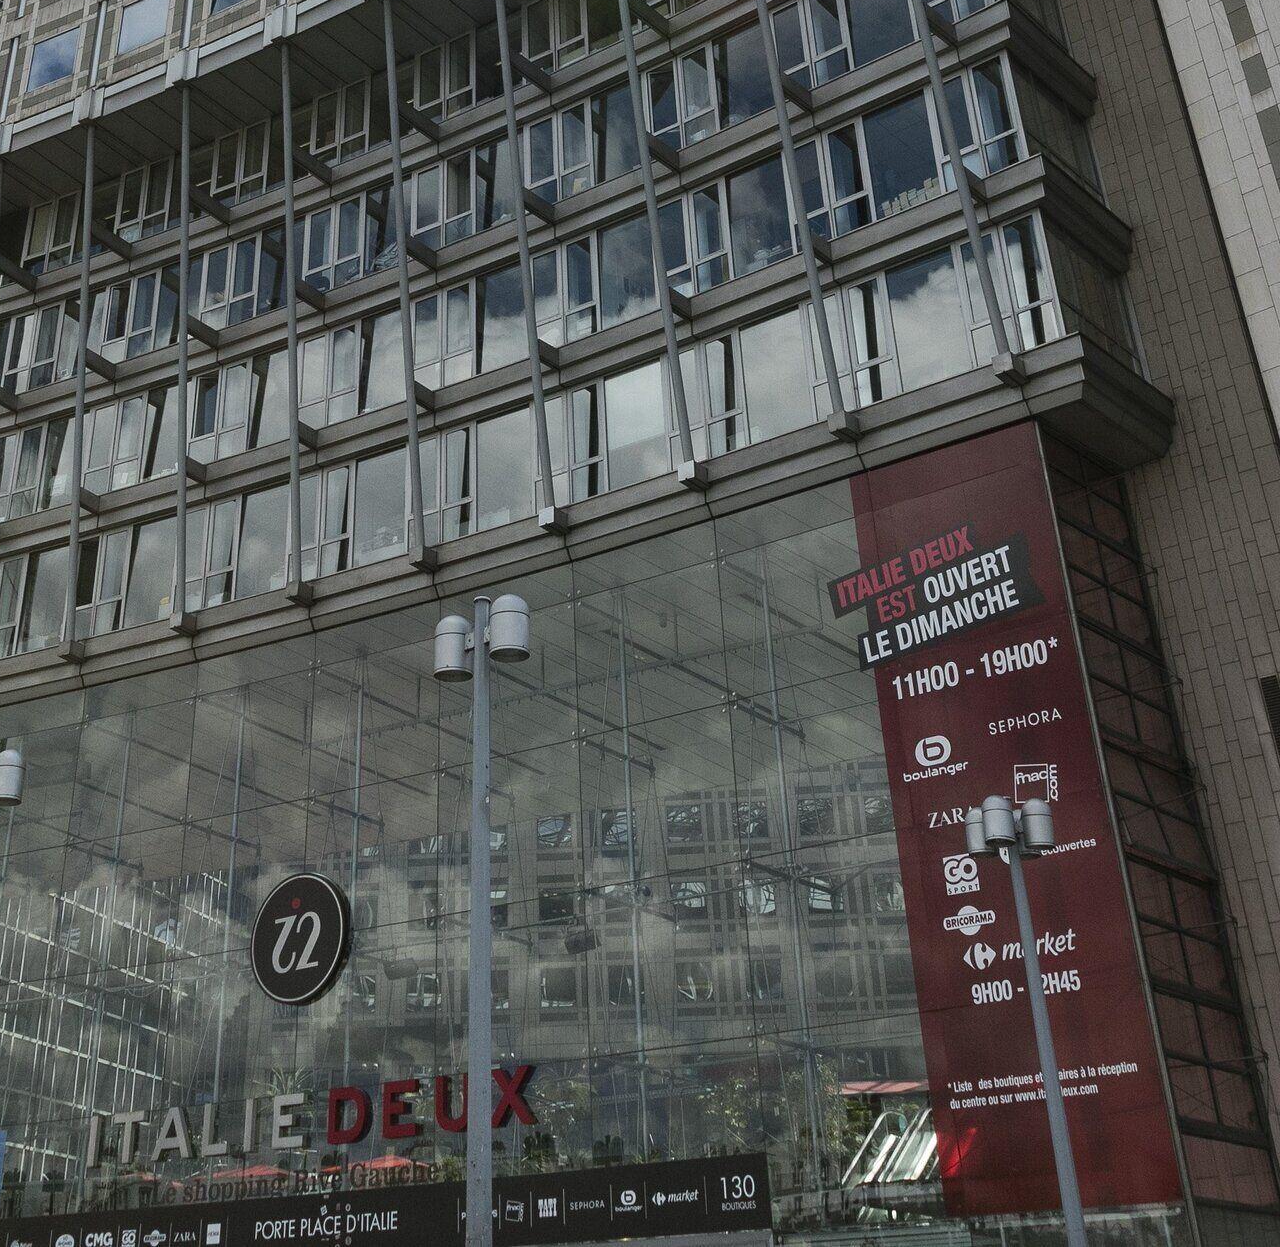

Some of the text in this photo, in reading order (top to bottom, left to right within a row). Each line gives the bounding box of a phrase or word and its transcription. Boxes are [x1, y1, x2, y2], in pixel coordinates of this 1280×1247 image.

[835, 526, 974, 608] ITALIE DEUX
[876, 545, 1011, 623] EST OUVERT
[863, 579, 1020, 663] LE DIMANCHE
[892, 660, 960, 700] 11H00
[988, 707, 1062, 735] SEPHORA
[903, 761, 969, 782] boulanger
[1016, 769, 1048, 785] fnac
[928, 806, 973, 829] ZAR
[944, 856, 978, 884] GO
[948, 883, 979, 895] SPORT
[945, 912, 994, 929] BRICORAMA
[1001, 928, 1077, 961] mrket
[971, 979, 1013, 1005] 9H00
[1041, 969, 1082, 995] 2H45
[953, 1061, 1138, 1093] Liste des boutiques et aires à la réception
[949, 1083, 1099, 1110] du centre ou sur www.iteux.com
[86, 1064, 538, 1169] ITALIE DEUX
[183, 1174, 288, 1202] shopping
[350, 1161, 437, 1188] Gauche
[720, 1174, 755, 1200] 130
[538, 1198, 557, 1217] TATI
[570, 1199, 605, 1211] SEPHORA
[614, 1204, 643, 1213] boulanger
[667, 1189, 700, 1204] market
[721, 1200, 757, 1211] BOUTIQUES
[121, 1232, 137, 1245] GO
[174, 1231, 196, 1242] ZARA
[254, 1210, 399, 1241] PORTE PLACE D'ITALIE
[85, 1231, 114, 1247] CMG
